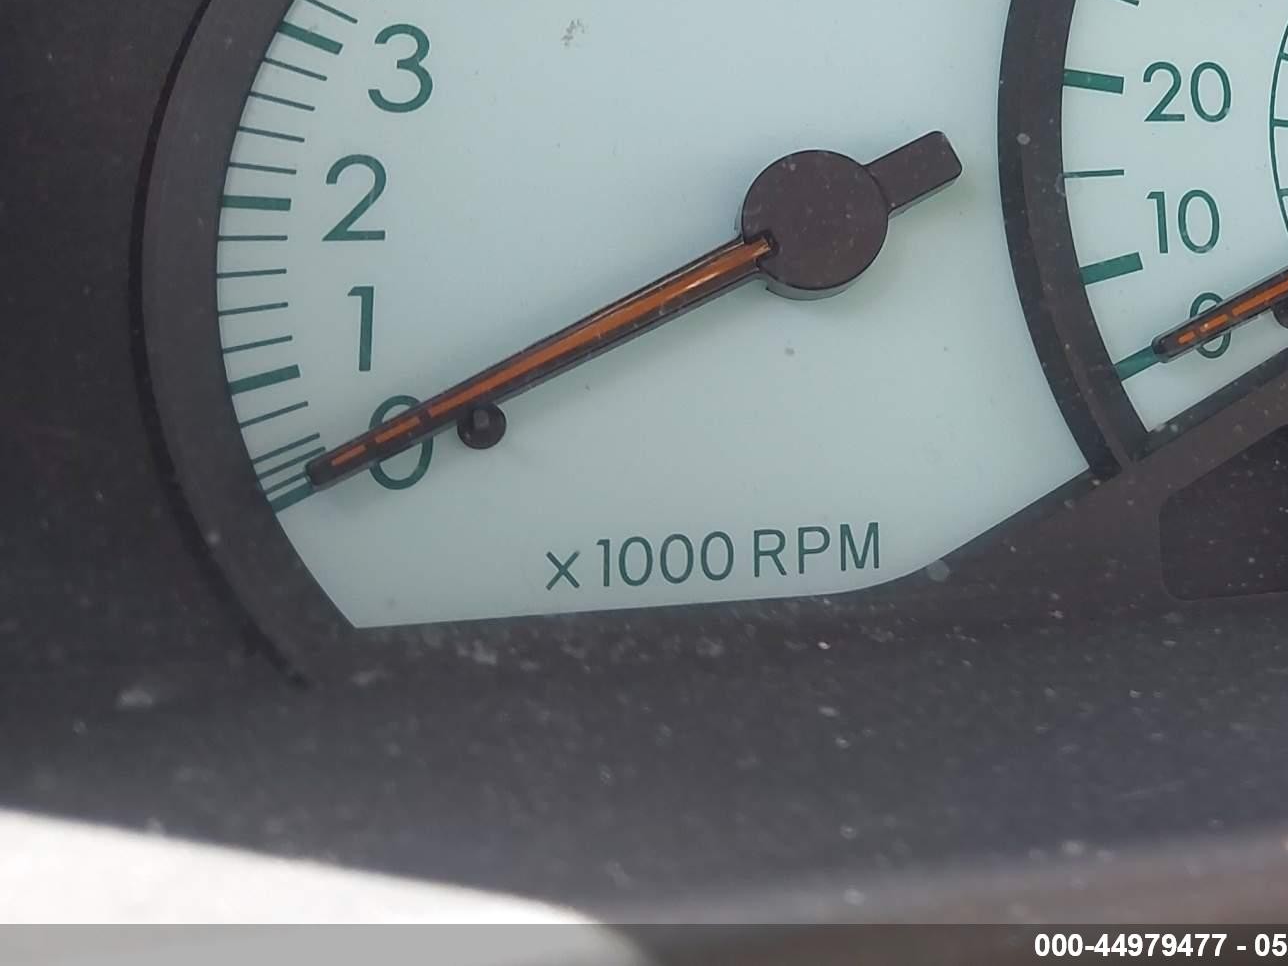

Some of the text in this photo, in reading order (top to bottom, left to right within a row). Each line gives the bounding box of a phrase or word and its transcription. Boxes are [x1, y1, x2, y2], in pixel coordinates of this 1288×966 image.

[368, 24, 433, 113] 3
[1143, 62, 1231, 122] 20
[322, 154, 386, 241] 2
[1147, 190, 1219, 253] 10
[348, 286, 374, 371] 1
[754, 522, 879, 578] RPM
